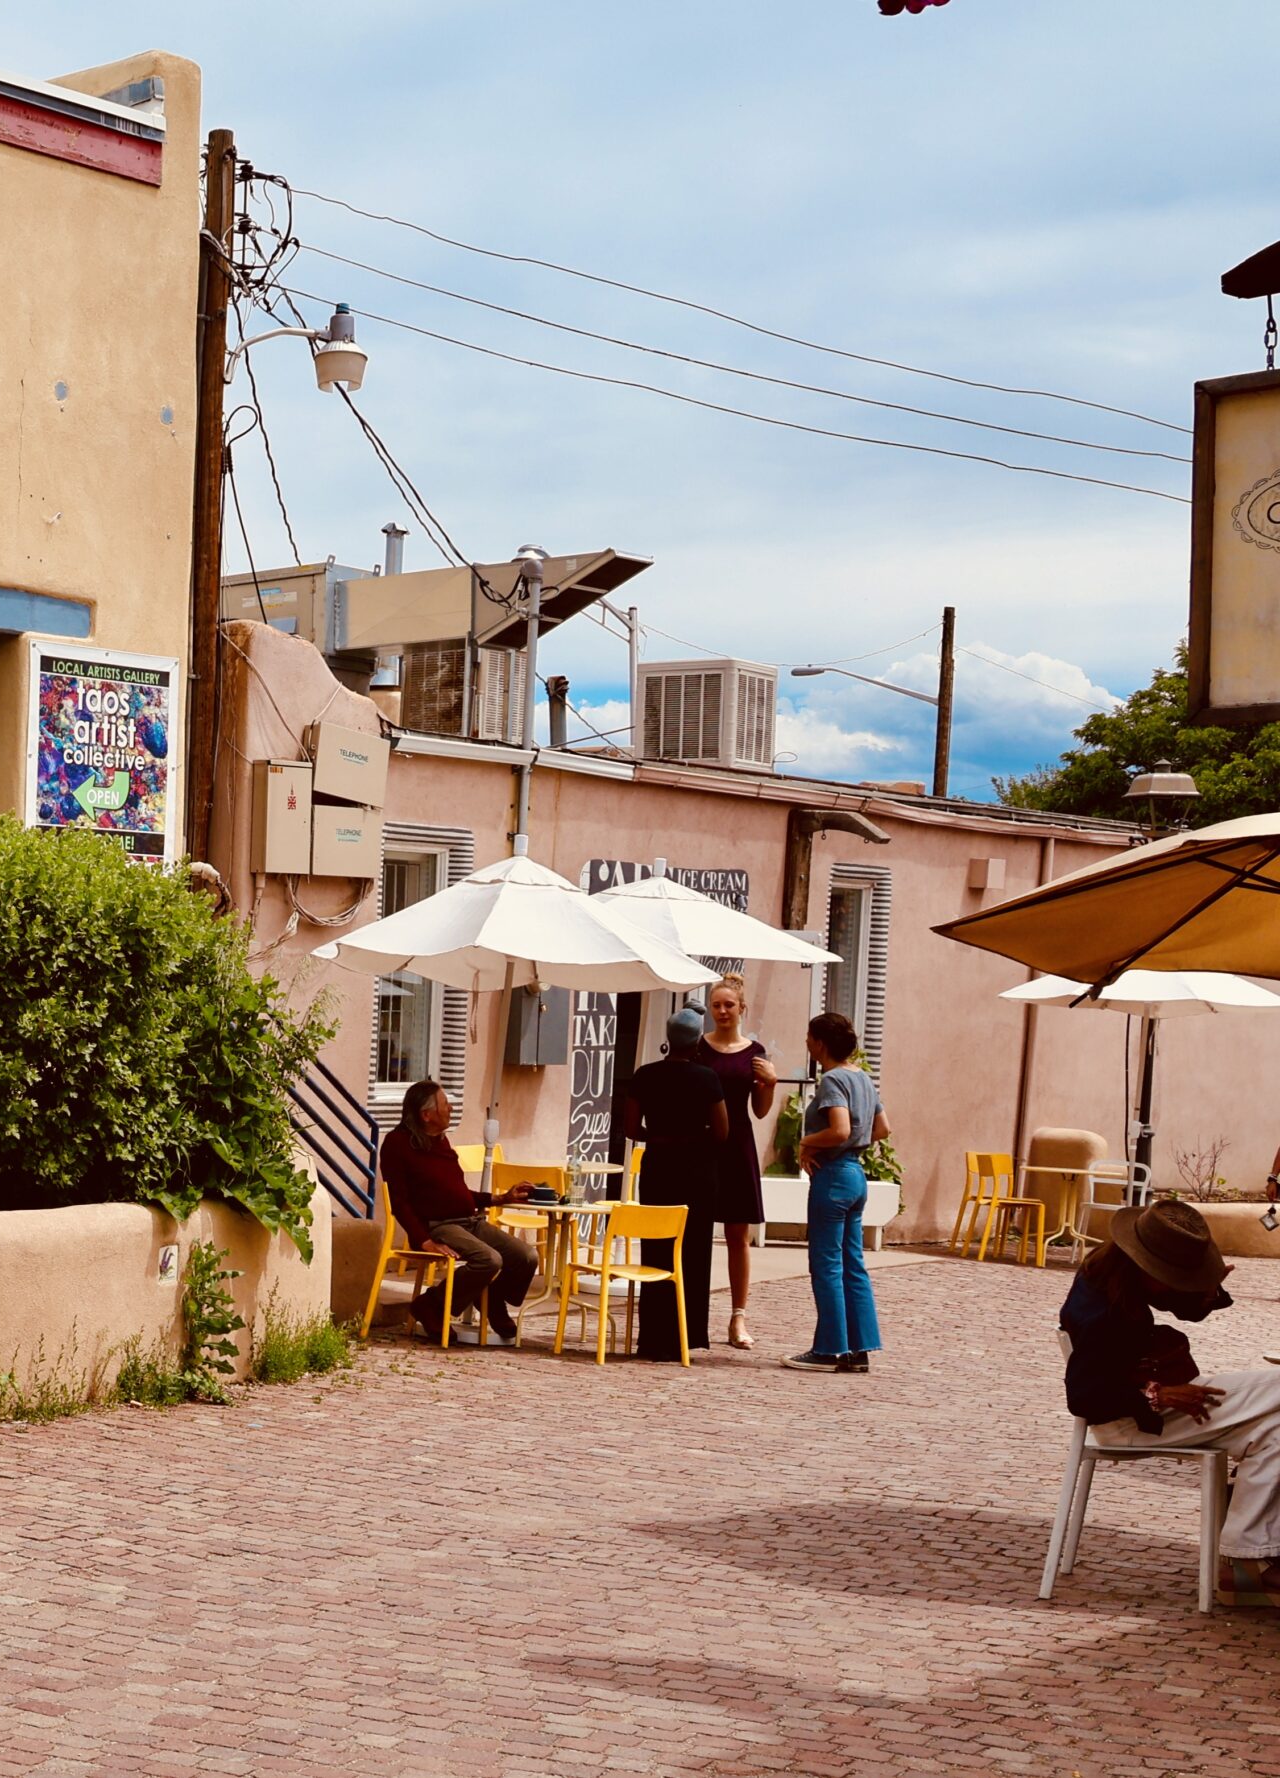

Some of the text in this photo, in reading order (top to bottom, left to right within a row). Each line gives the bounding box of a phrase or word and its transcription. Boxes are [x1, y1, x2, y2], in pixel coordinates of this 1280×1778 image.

[52, 660, 161, 686] LOCAL ARTISTS GALLERY
[77, 680, 130, 716] taos
[74, 715, 136, 748] artist
[63, 745, 146, 771] collective
[339, 748, 369, 763] TELEPHONE
[86, 789, 120, 806] OPEN
[677, 869, 747, 891] ICE CREAM
